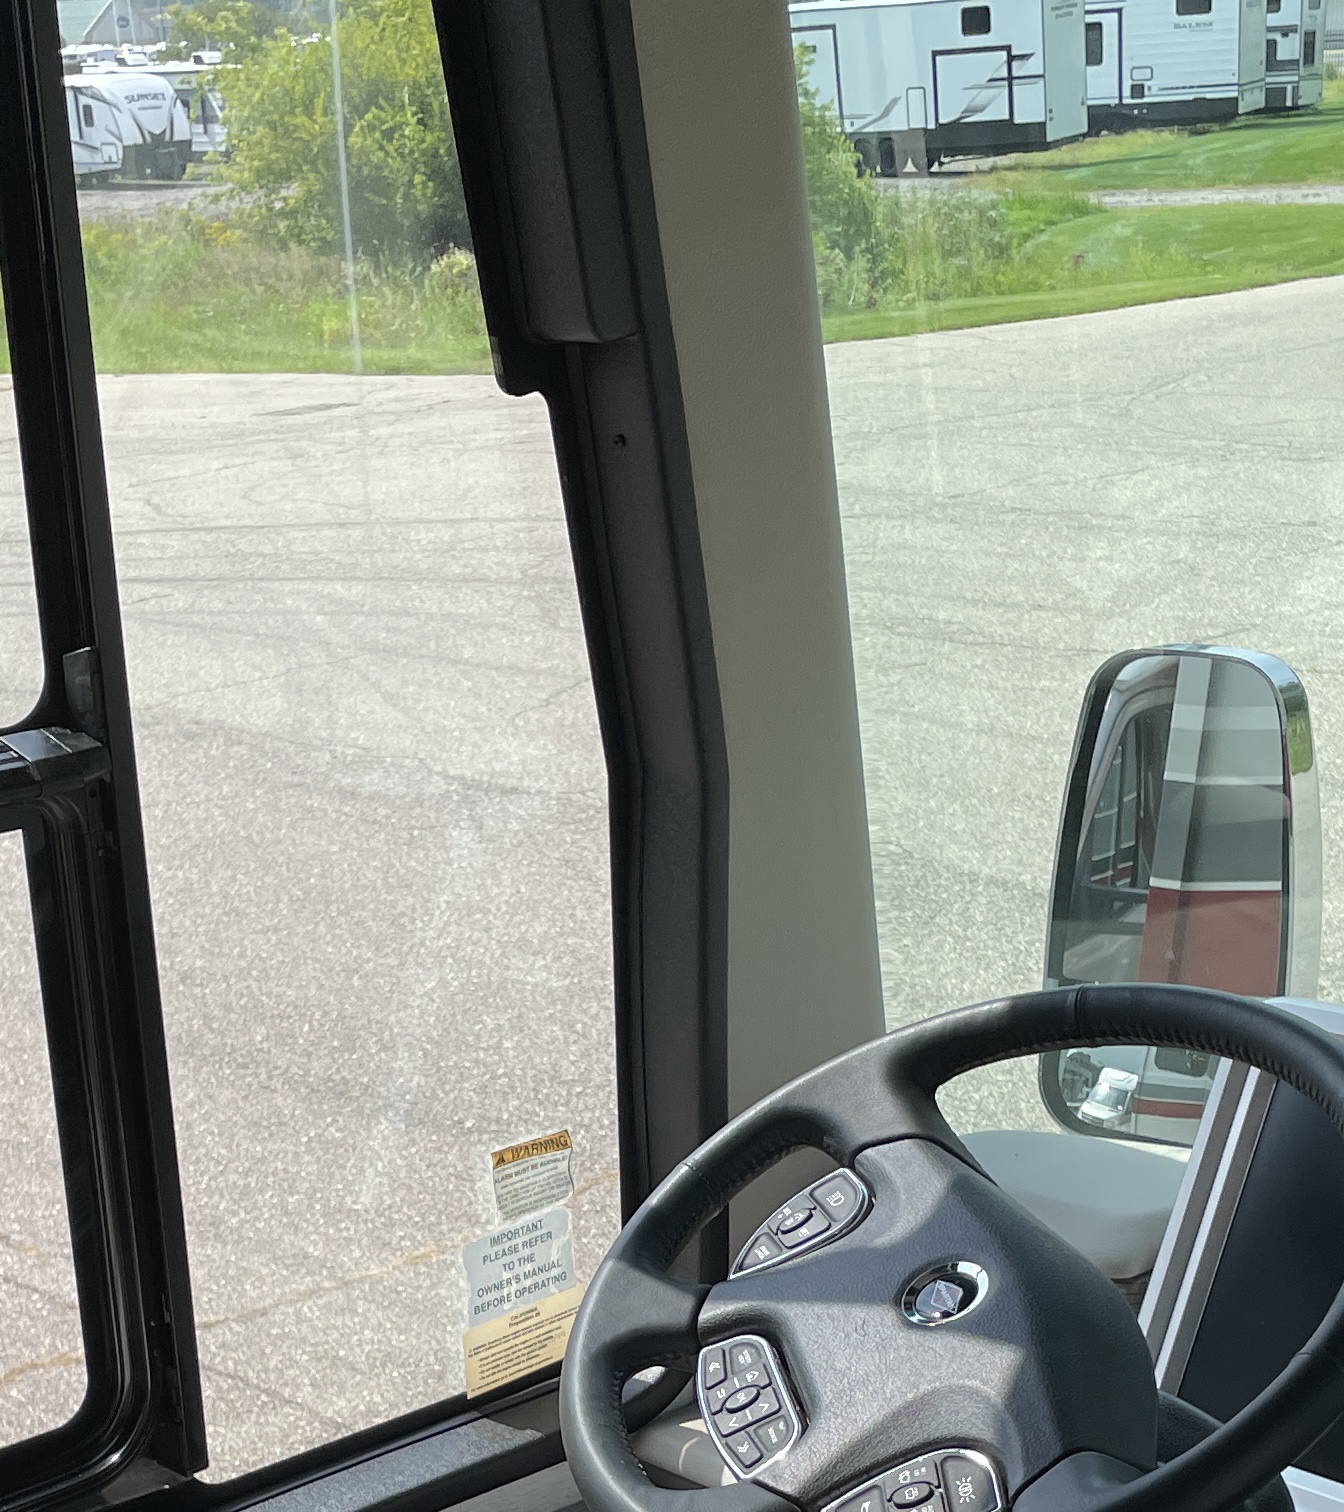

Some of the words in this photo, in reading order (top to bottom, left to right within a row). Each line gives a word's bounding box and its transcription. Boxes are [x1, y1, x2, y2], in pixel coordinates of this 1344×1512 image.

[511, 1135, 568, 1160] WARNING
[482, 1243, 520, 1265] PLEASE
[522, 1231, 553, 1249] REFER
[489, 1219, 544, 1248] IMPORTANT
[502, 1261, 515, 1272] TO
[517, 1253, 536, 1267] THE
[474, 1292, 512, 1315] BEFORE
[514, 1271, 567, 1299] OPERATING
[477, 1274, 521, 1298] OWNER'S
[523, 1259, 562, 1280] MANUAL
